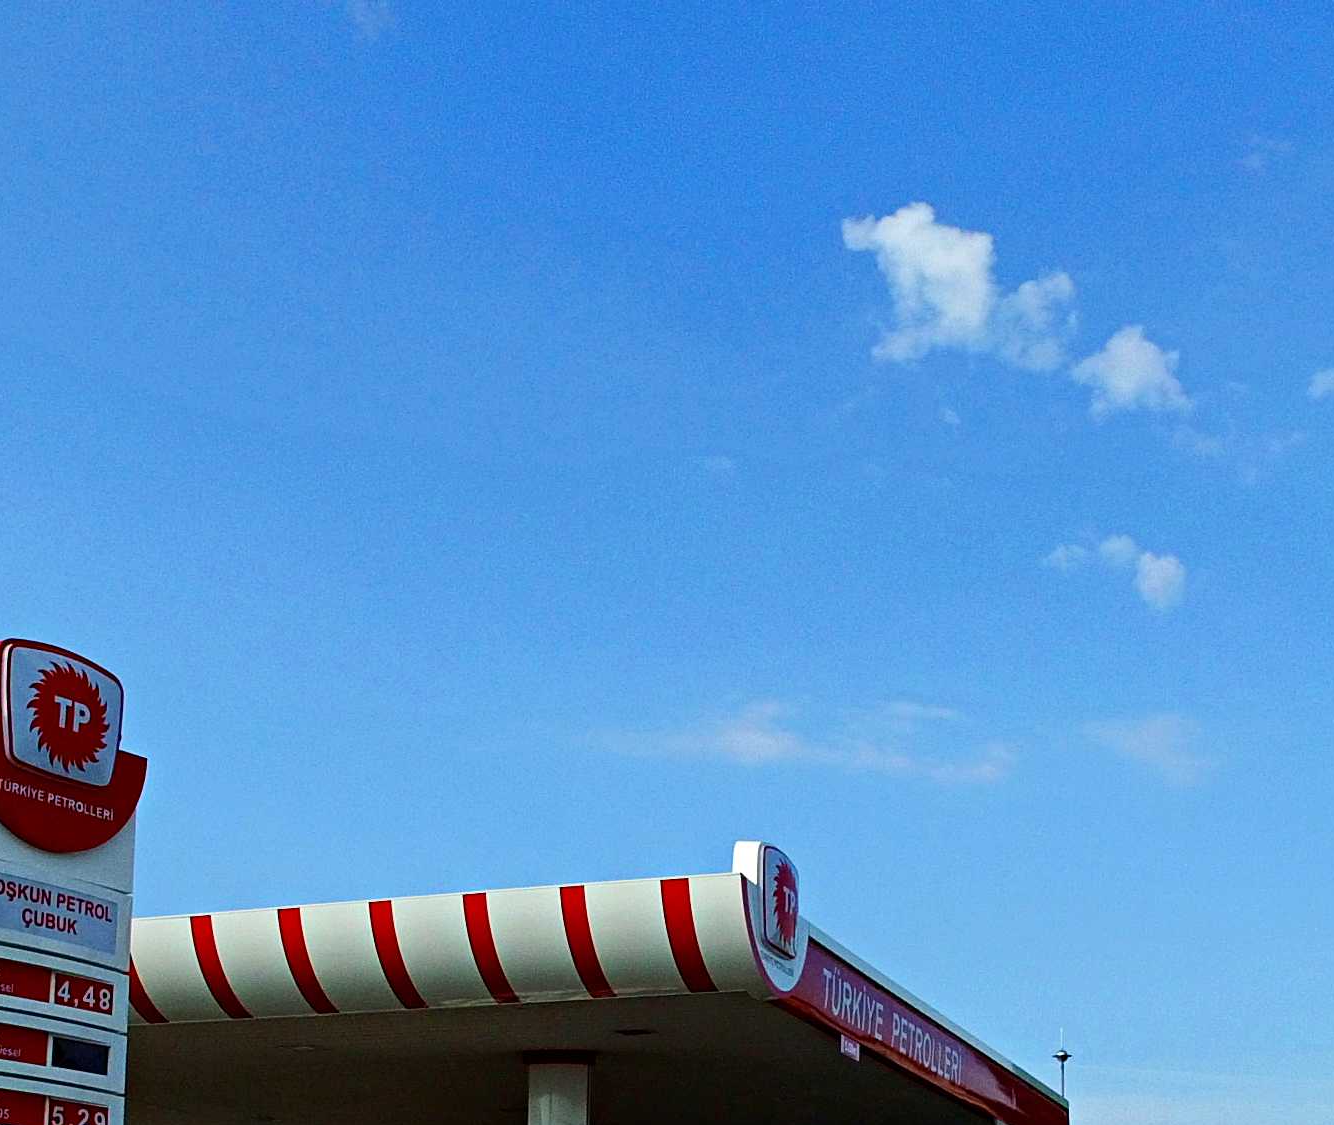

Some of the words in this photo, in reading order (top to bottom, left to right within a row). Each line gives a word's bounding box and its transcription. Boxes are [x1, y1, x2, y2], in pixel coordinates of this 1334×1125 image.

[54, 695, 91, 733] TP
[47, 792, 114, 821] PETROLLERİ
[56, 893, 113, 923] PETROL
[782, 886, 796, 915] TP
[21, 908, 78, 935] ÇUBUK
[57, 980, 111, 1010] 4,48
[822, 966, 884, 1041] TÜRKİYE
